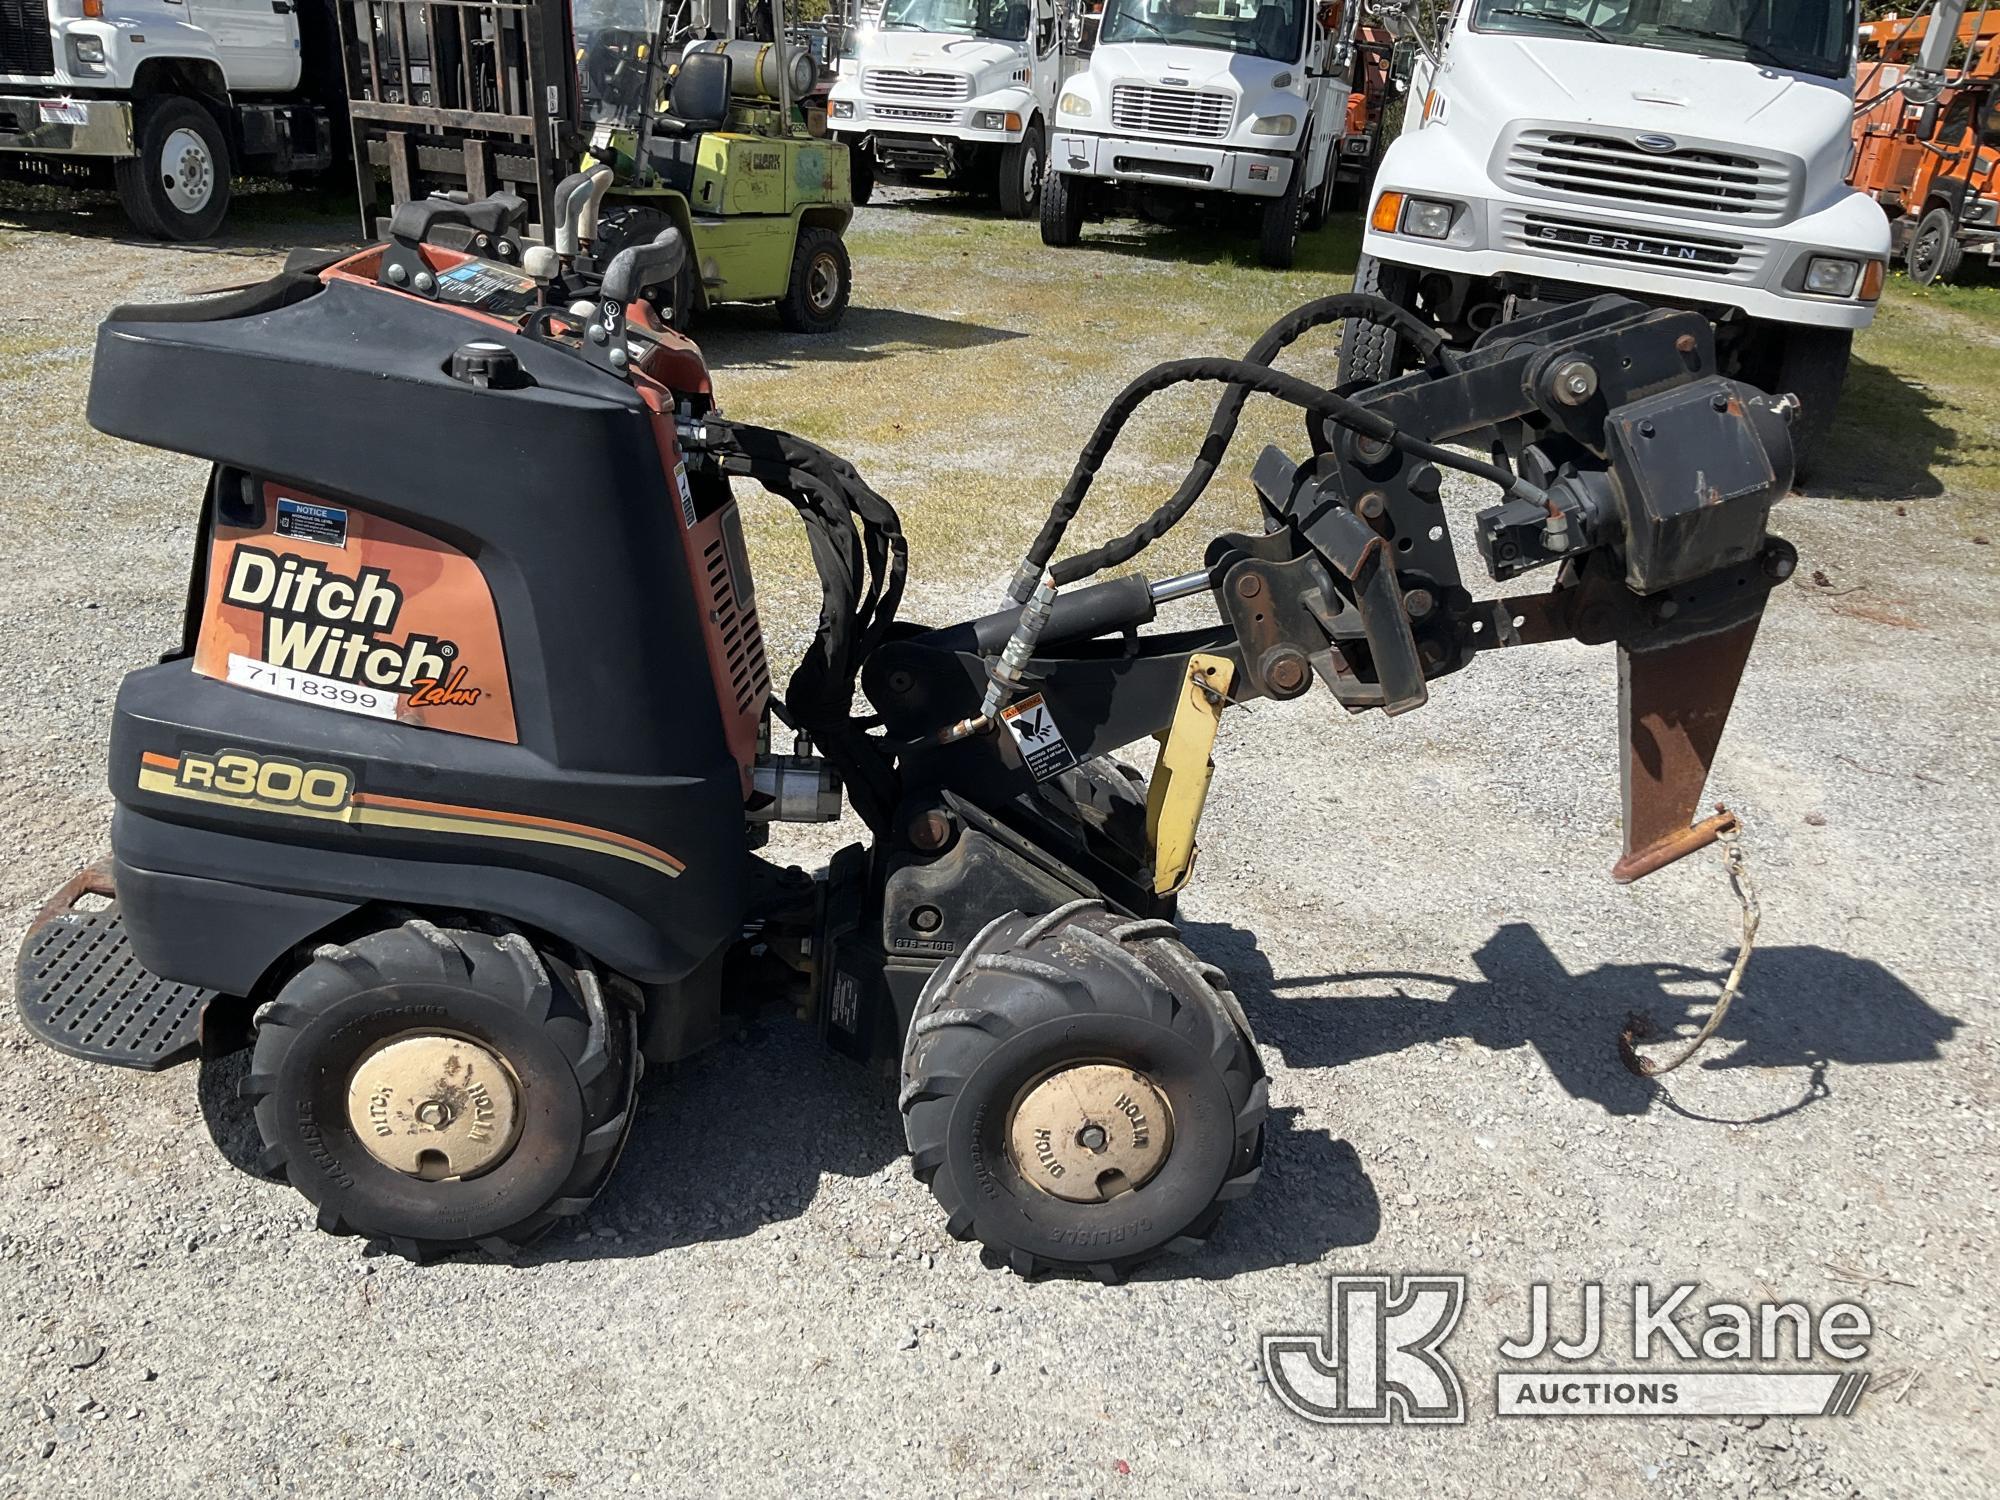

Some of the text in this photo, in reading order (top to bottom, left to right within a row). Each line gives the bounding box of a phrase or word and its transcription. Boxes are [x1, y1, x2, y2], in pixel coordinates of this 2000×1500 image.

[296, 505, 328, 518] NOTICE
[228, 551, 396, 626] Ditch
[247, 665, 377, 708] 7118399
[407, 665, 482, 707] Zahn
[182, 755, 348, 807] R300
[1113, 1092, 1150, 1149] WITCH
[1033, 1128, 1067, 1180] DITCH
